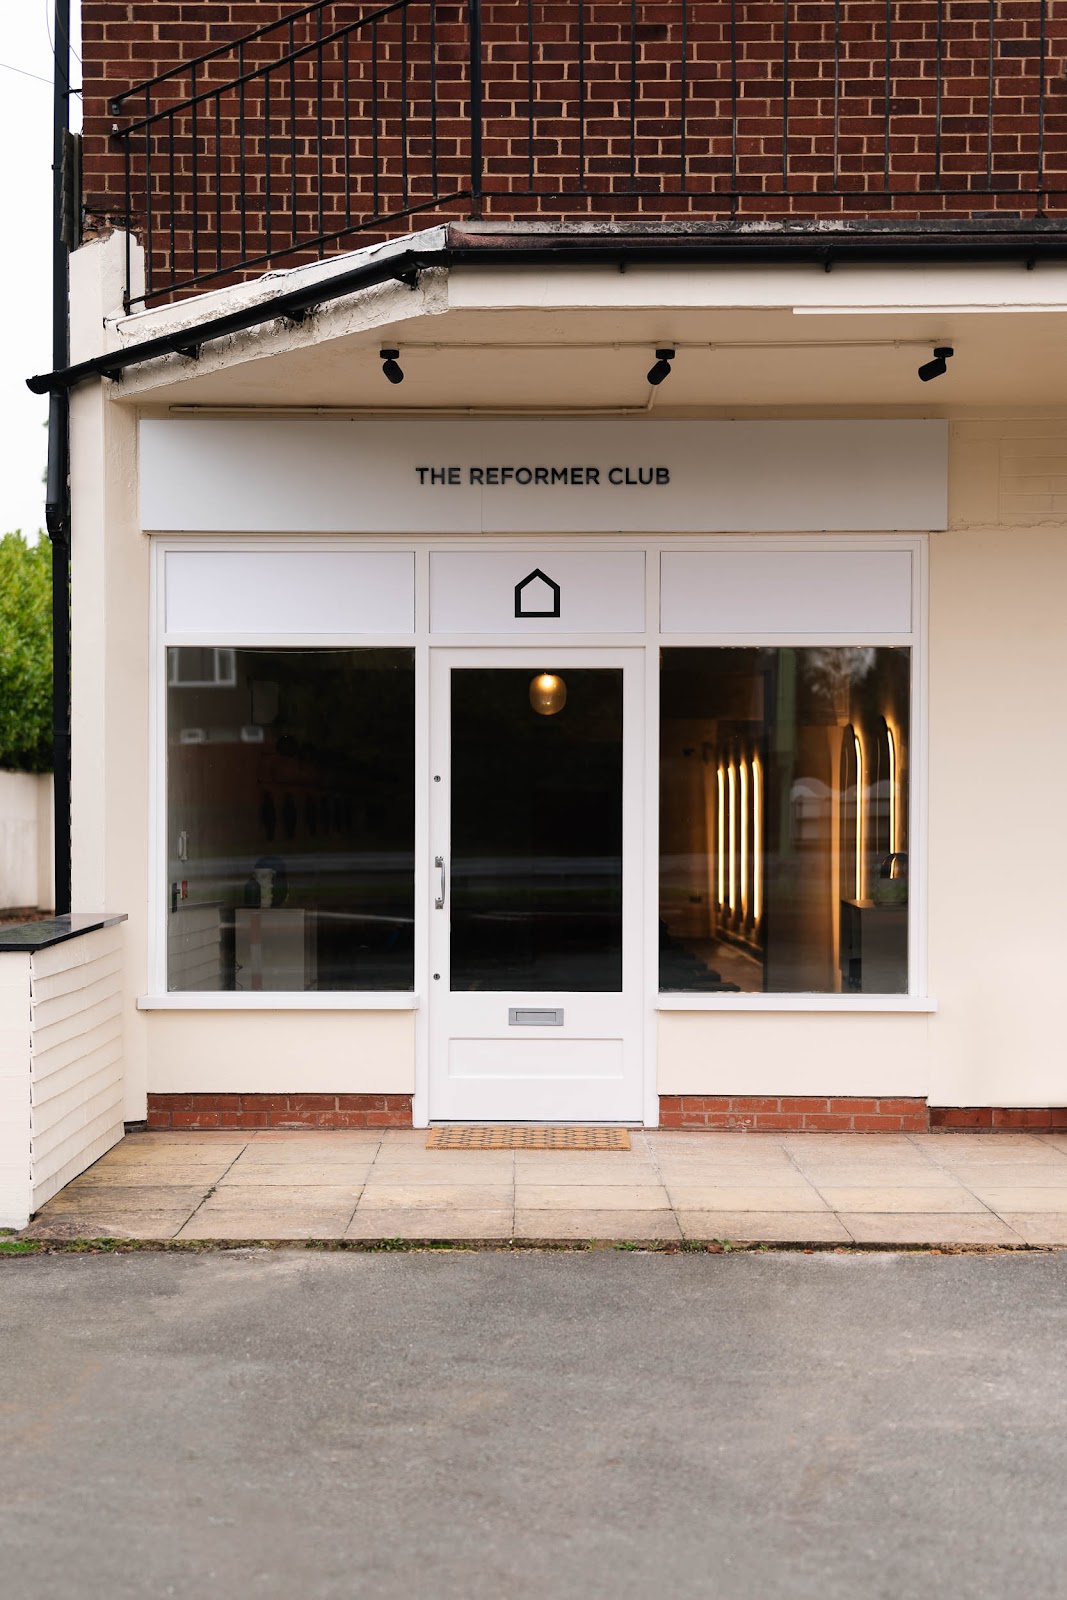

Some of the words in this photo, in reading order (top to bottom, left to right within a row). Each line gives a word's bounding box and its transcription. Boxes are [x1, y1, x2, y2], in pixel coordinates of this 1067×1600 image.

[415, 467, 461, 485] THE
[471, 467, 600, 485] REFORMER
[608, 467, 670, 485] CLUB
